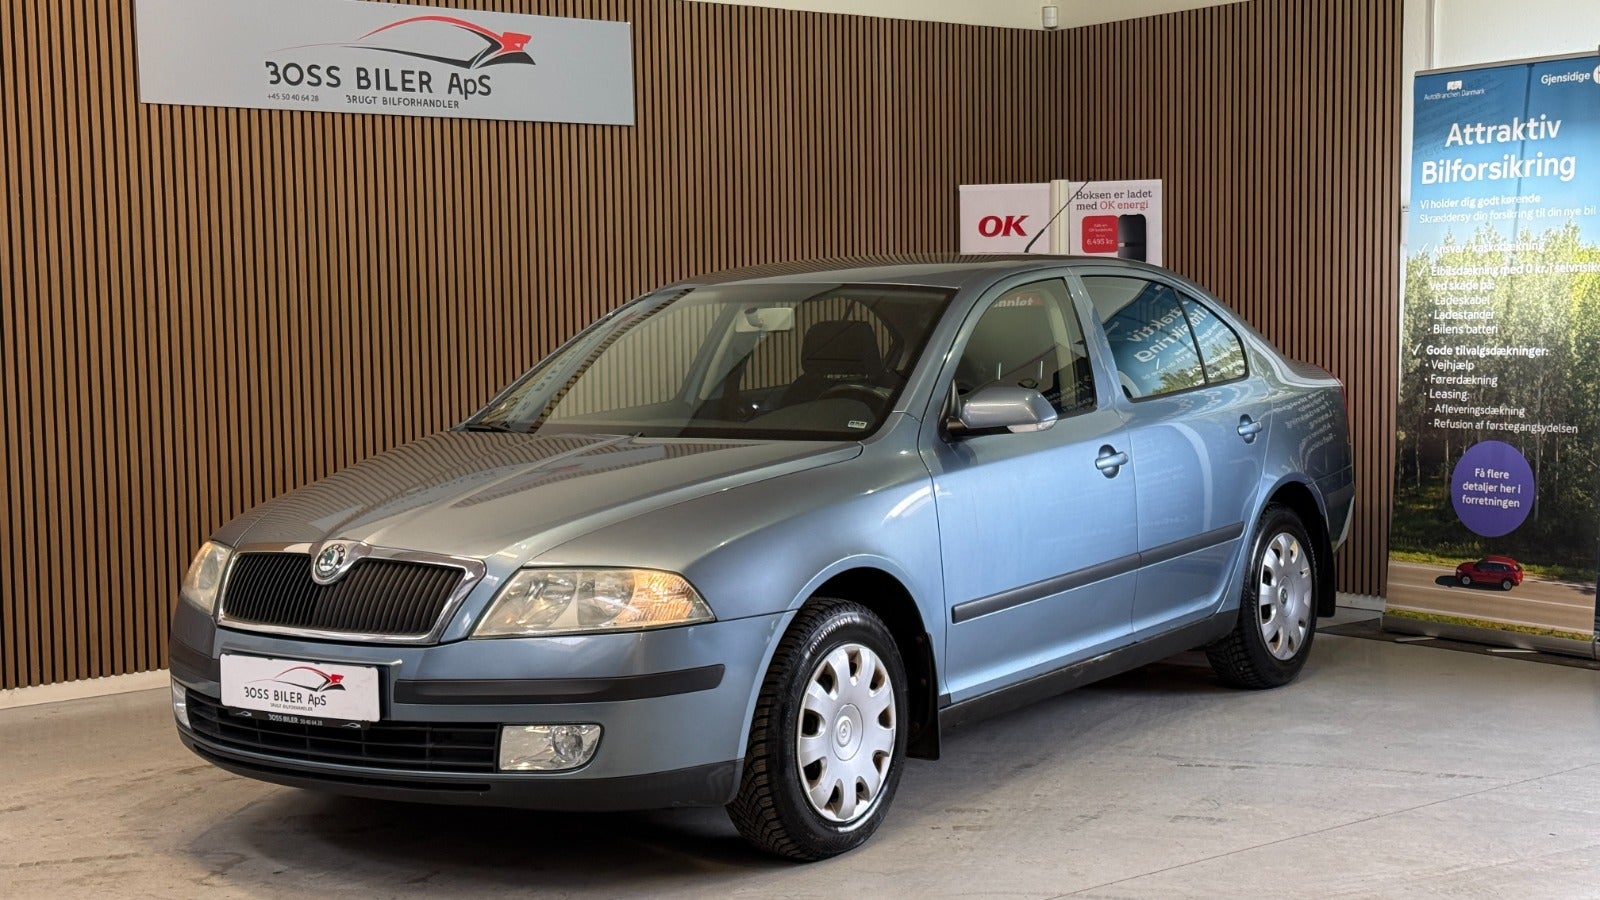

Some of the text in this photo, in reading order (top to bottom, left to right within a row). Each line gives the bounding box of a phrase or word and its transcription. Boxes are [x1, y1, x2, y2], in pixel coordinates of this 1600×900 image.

[356, 67, 433, 93] BILER
[448, 72, 492, 99] ApS
[1541, 71, 1591, 86] Gjensidige
[301, 94, 309, 102] 64
[1461, 88, 1485, 97] Danmark
[382, 97, 460, 109] BILFORHANDLER
[1445, 114, 1562, 147] Attraktiv
[1421, 152, 1577, 185] Bilforsikring
[1076, 191, 1112, 200] Boksen
[1127, 189, 1153, 199] ladet
[1076, 199, 1149, 210] med OK energi
[1420, 200, 1430, 210] Vi
[1431, 198, 1459, 209] holder
[1461, 196, 1475, 209] dig
[1477, 196, 1500, 209] godt
[1419, 205, 1596, 225] Skræddersy din forsikring til din nye bil
[978, 215, 1030, 237] OK
[1500, 264, 1523, 276] med
[1525, 264, 1533, 274] 0
[1430, 281, 1447, 291] ved
[1449, 280, 1478, 290] skade
[1435, 295, 1490, 306] Ladeskabel
[1434, 310, 1495, 320] Ladestander
[1433, 324, 1498, 335] Bilens batteri
[1426, 344, 1549, 359] Gode tilvalgsdækninger:
[1431, 359, 1475, 371] Vejhjælp
[1430, 374, 1498, 388] Førerdækning
[1429, 389, 1470, 401] Leasing:
[1434, 403, 1525, 418] Afleveringsdækning
[1434, 418, 1578, 435] Refusion af førstegangsydelsen
[1475, 467, 1510, 479] Få flere
[1462, 481, 1521, 494] detaljer her i
[1462, 494, 1520, 509] forretningen
[273, 690, 303, 704] BILER
[307, 694, 327, 708] ApS
